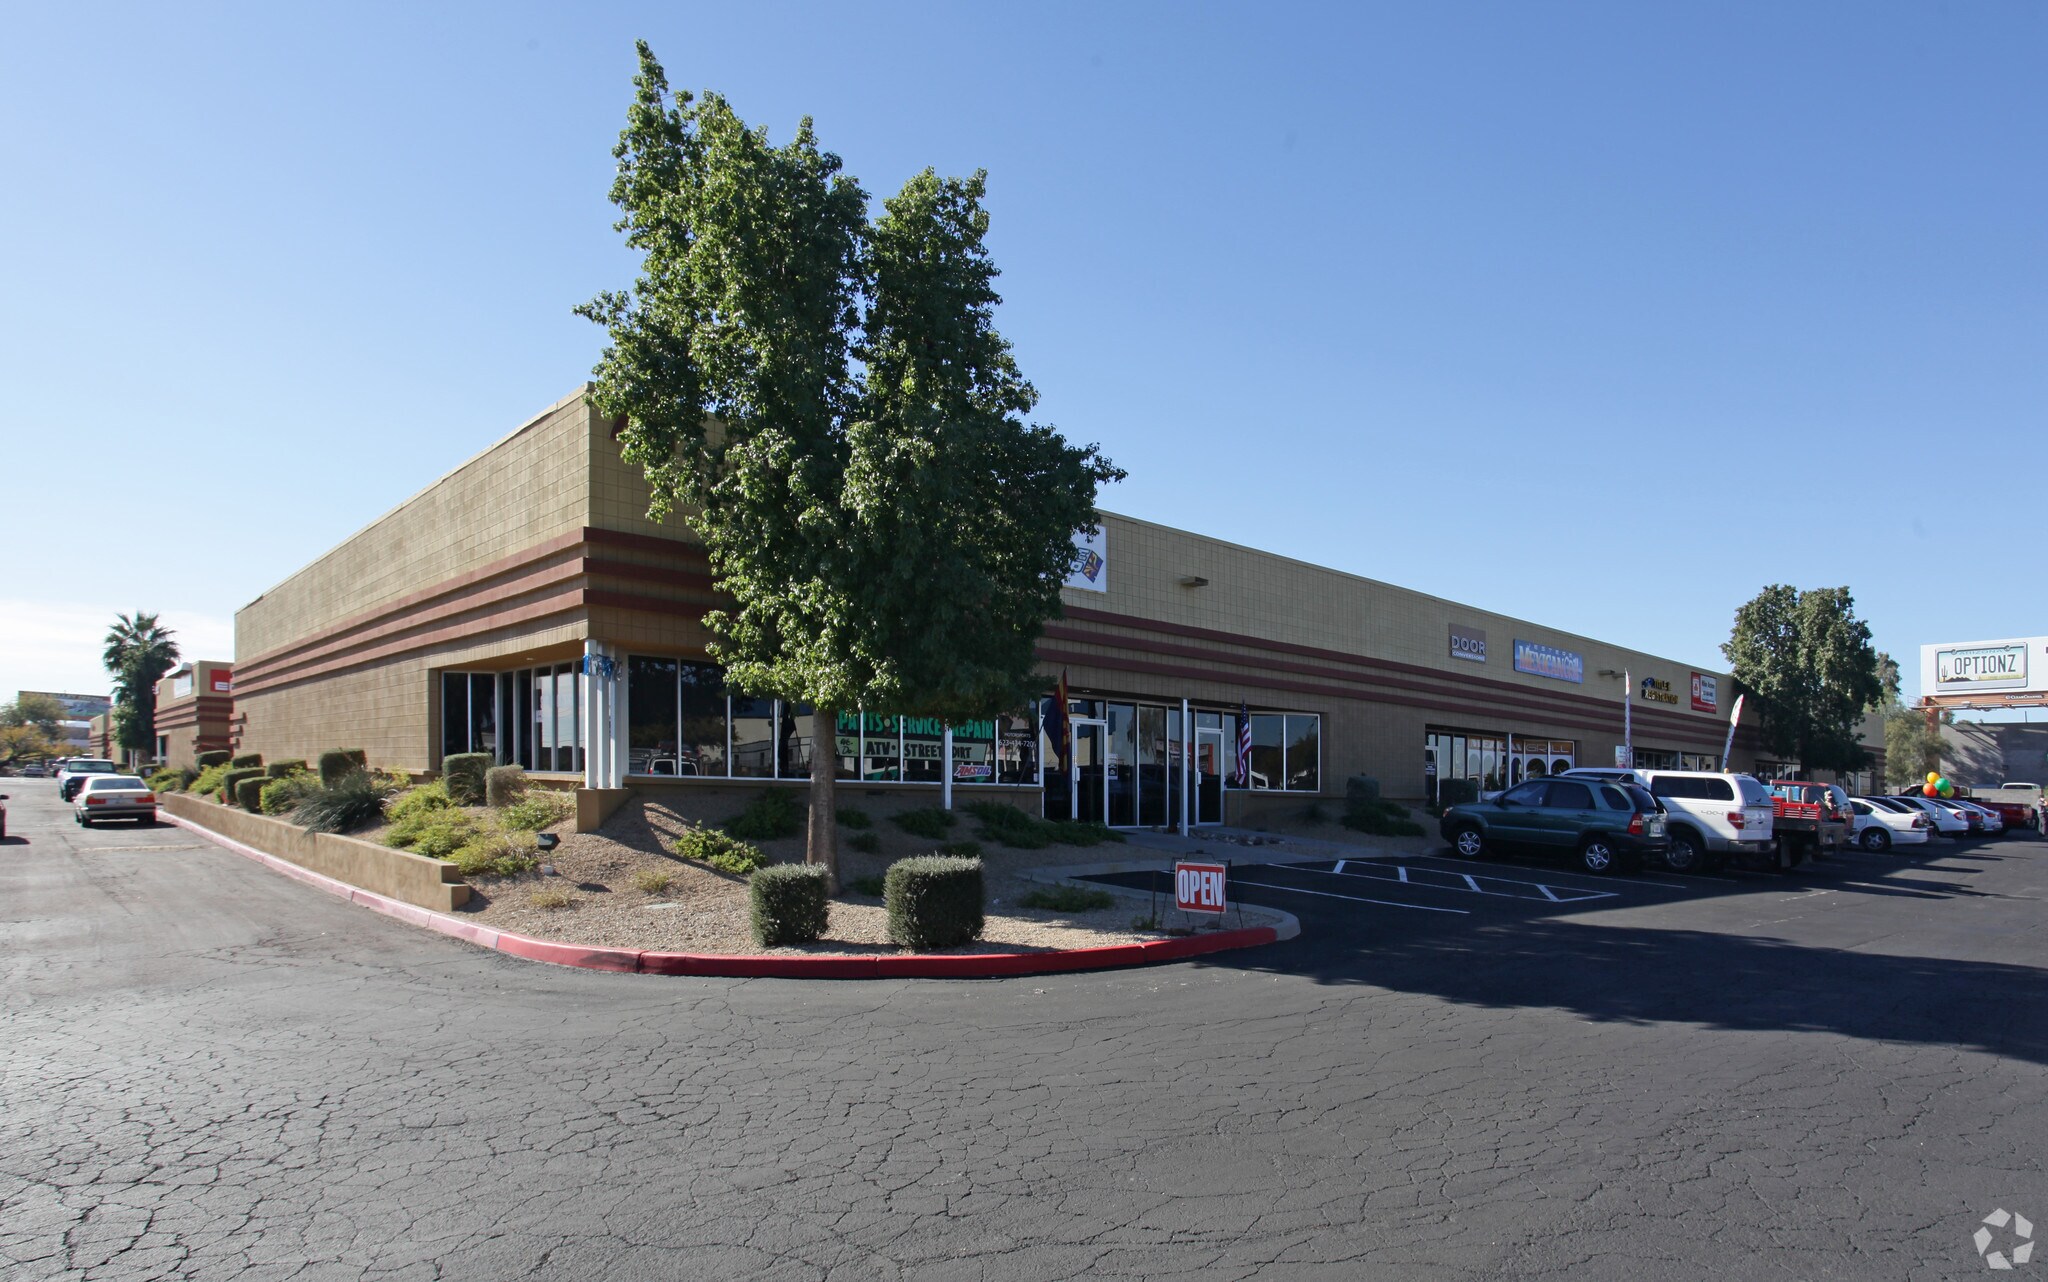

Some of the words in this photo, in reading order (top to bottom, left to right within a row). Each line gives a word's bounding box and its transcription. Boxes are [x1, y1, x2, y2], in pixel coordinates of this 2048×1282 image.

[1451, 635, 1486, 655] DOOR
[1519, 645, 1565, 678] MEXICAN
[1954, 653, 2017, 675] OPTIONZ
[838, 709, 884, 733] PARTS
[891, 713, 942, 736] SERVICE
[952, 719, 994, 740] REPAIR
[865, 740, 891, 756] ATV
[904, 742, 942, 758] STREET
[952, 745, 972, 760] DIRT
[955, 765, 992, 778] AMSOIL
[1177, 869, 1223, 907] OPEN
